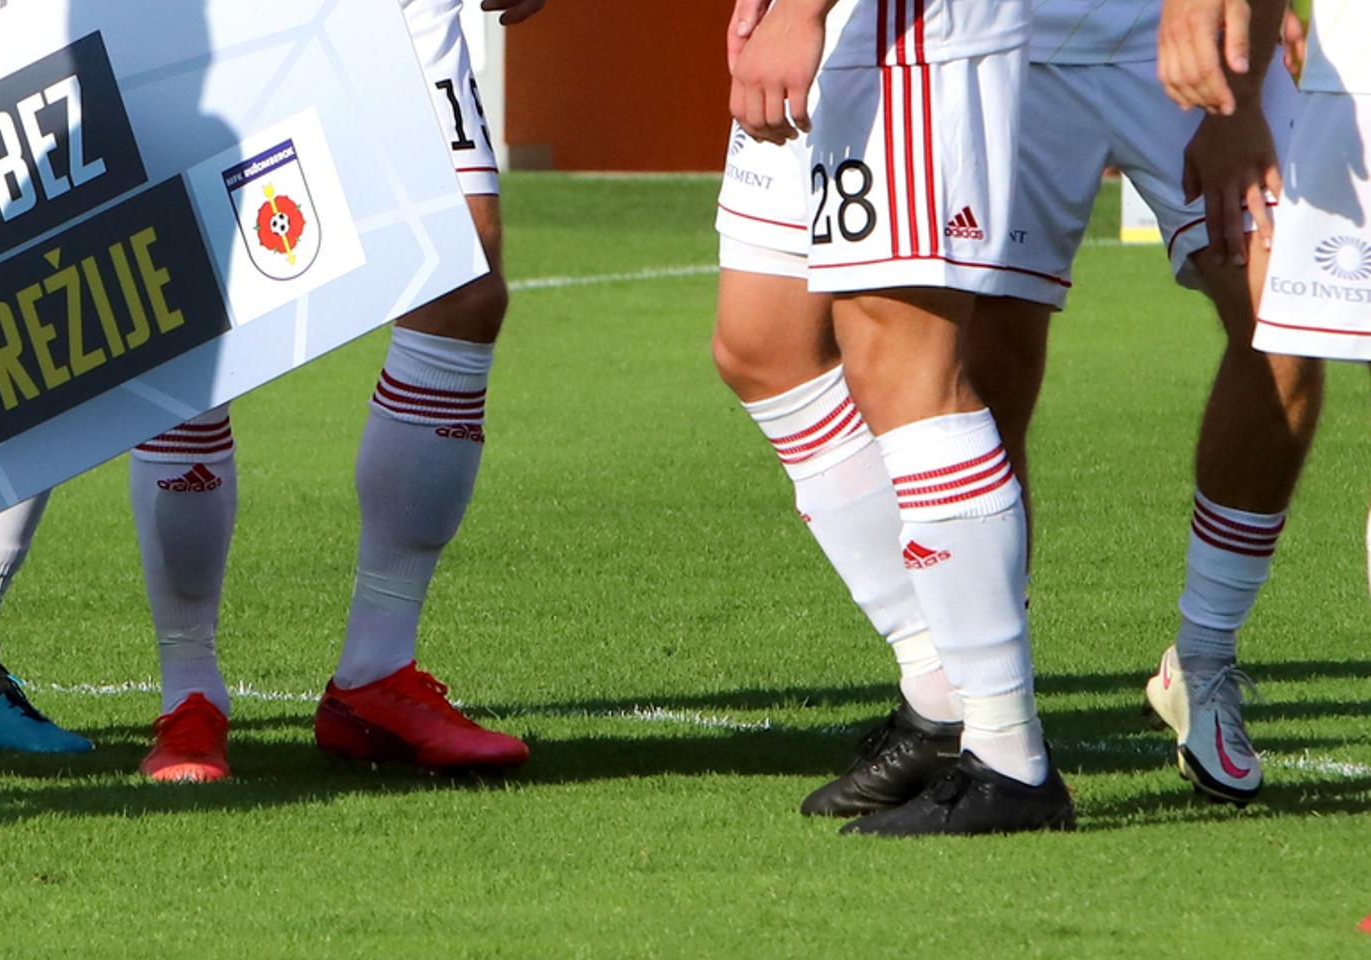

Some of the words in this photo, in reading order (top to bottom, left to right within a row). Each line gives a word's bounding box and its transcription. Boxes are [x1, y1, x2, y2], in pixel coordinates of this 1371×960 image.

[811, 158, 877, 245] 28
[944, 225, 983, 240] adidas
[1270, 276, 1307, 296] ECO
[157, 477, 222, 492] adidas
